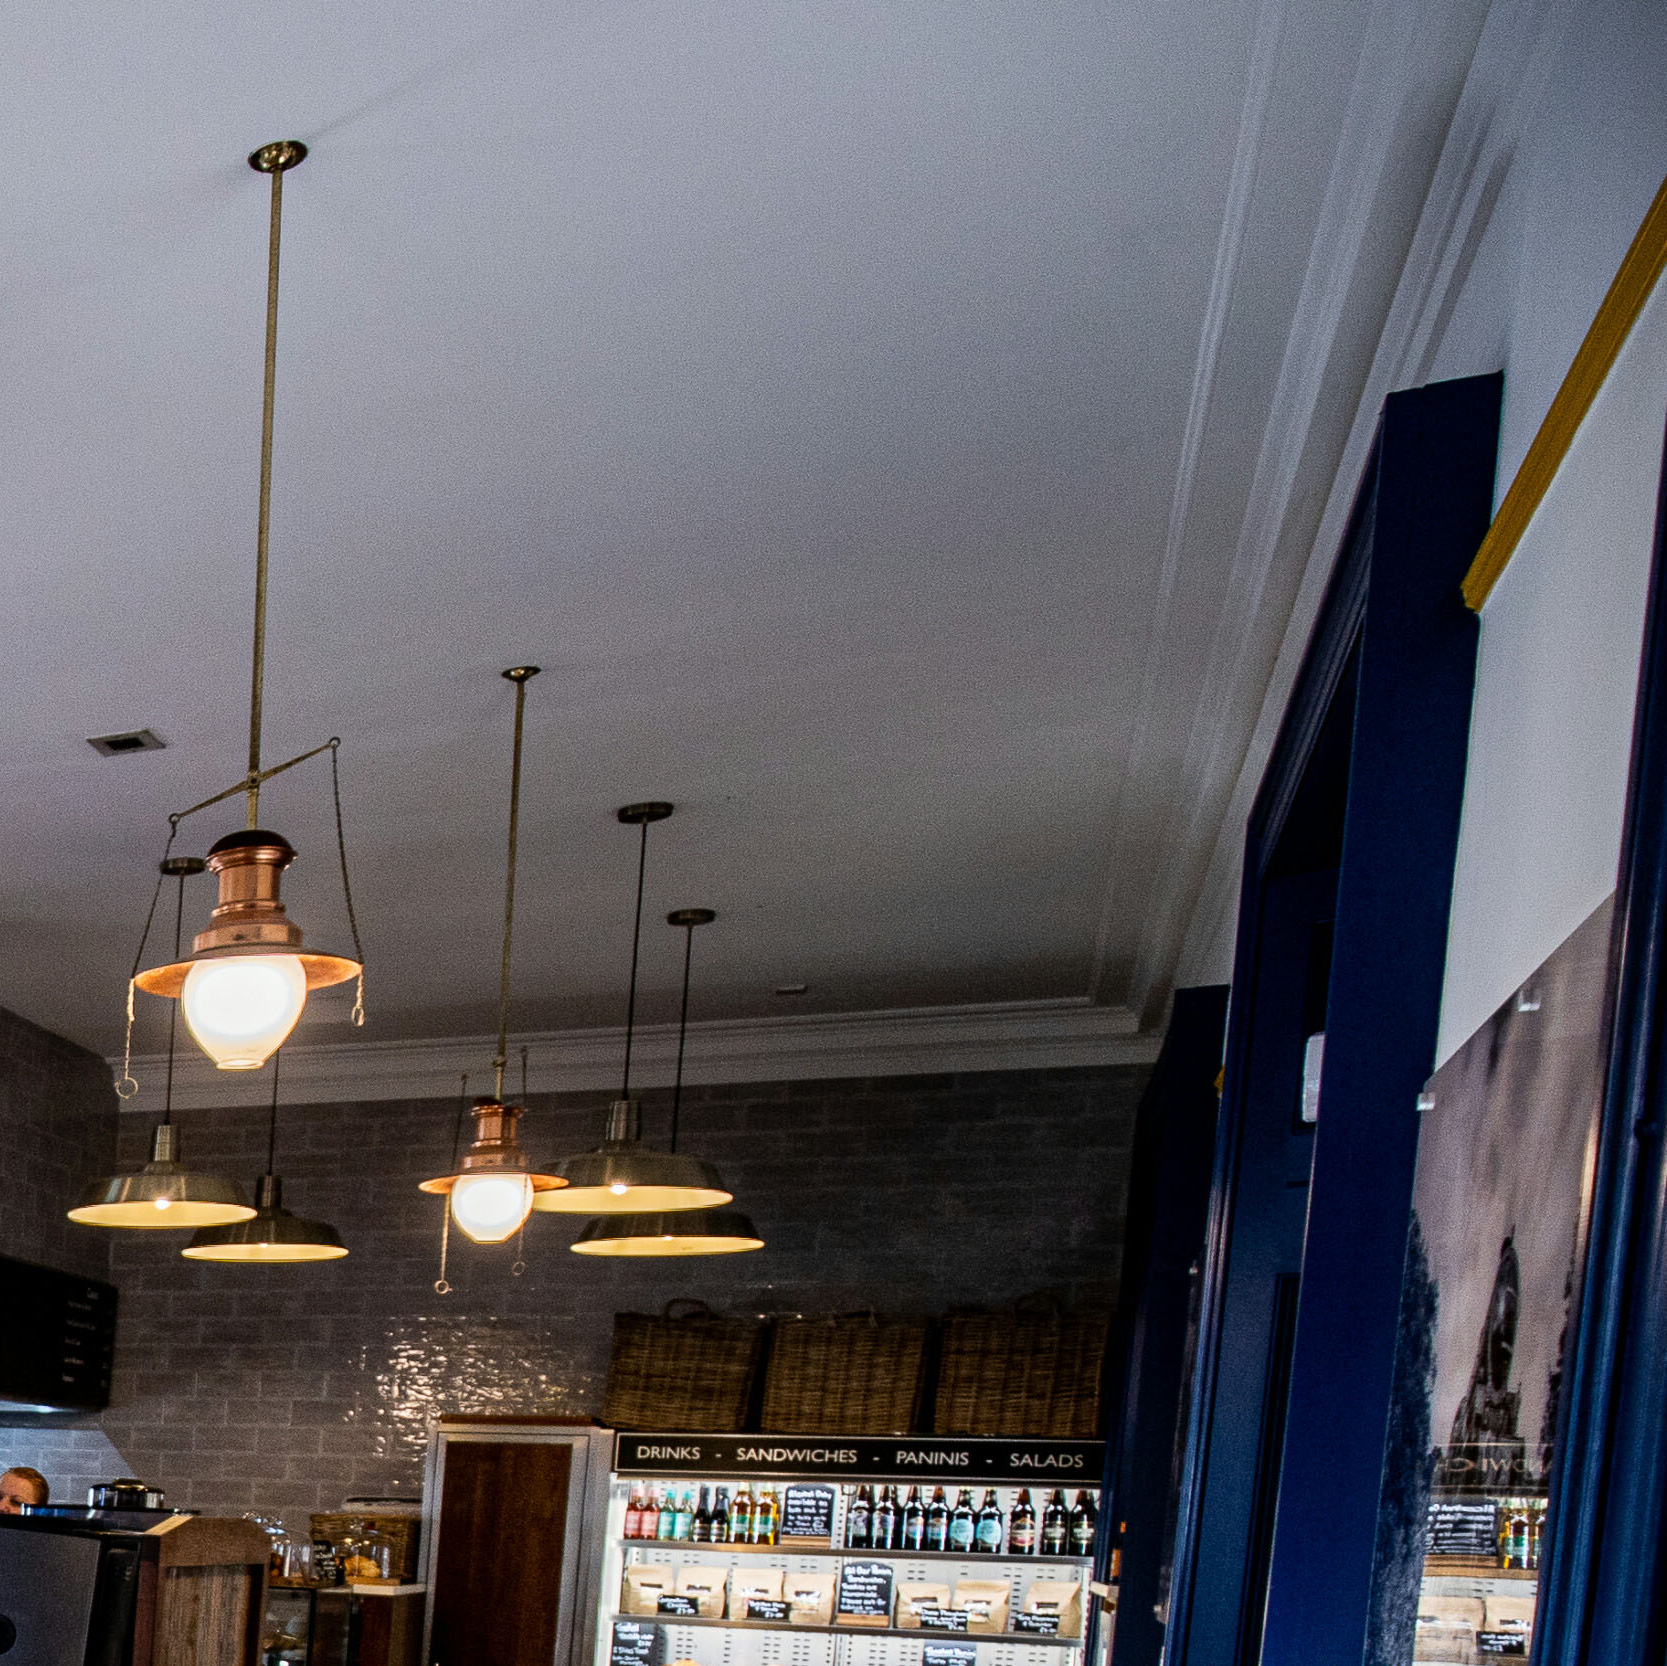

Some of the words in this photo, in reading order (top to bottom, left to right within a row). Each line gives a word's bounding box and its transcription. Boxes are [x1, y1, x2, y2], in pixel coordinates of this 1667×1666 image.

[636, 1445, 701, 1461] DRINKS
[736, 1447, 858, 1464] SANDWICHES
[896, 1450, 970, 1467] PANINIS
[1009, 1452, 1085, 1468] SALADS
